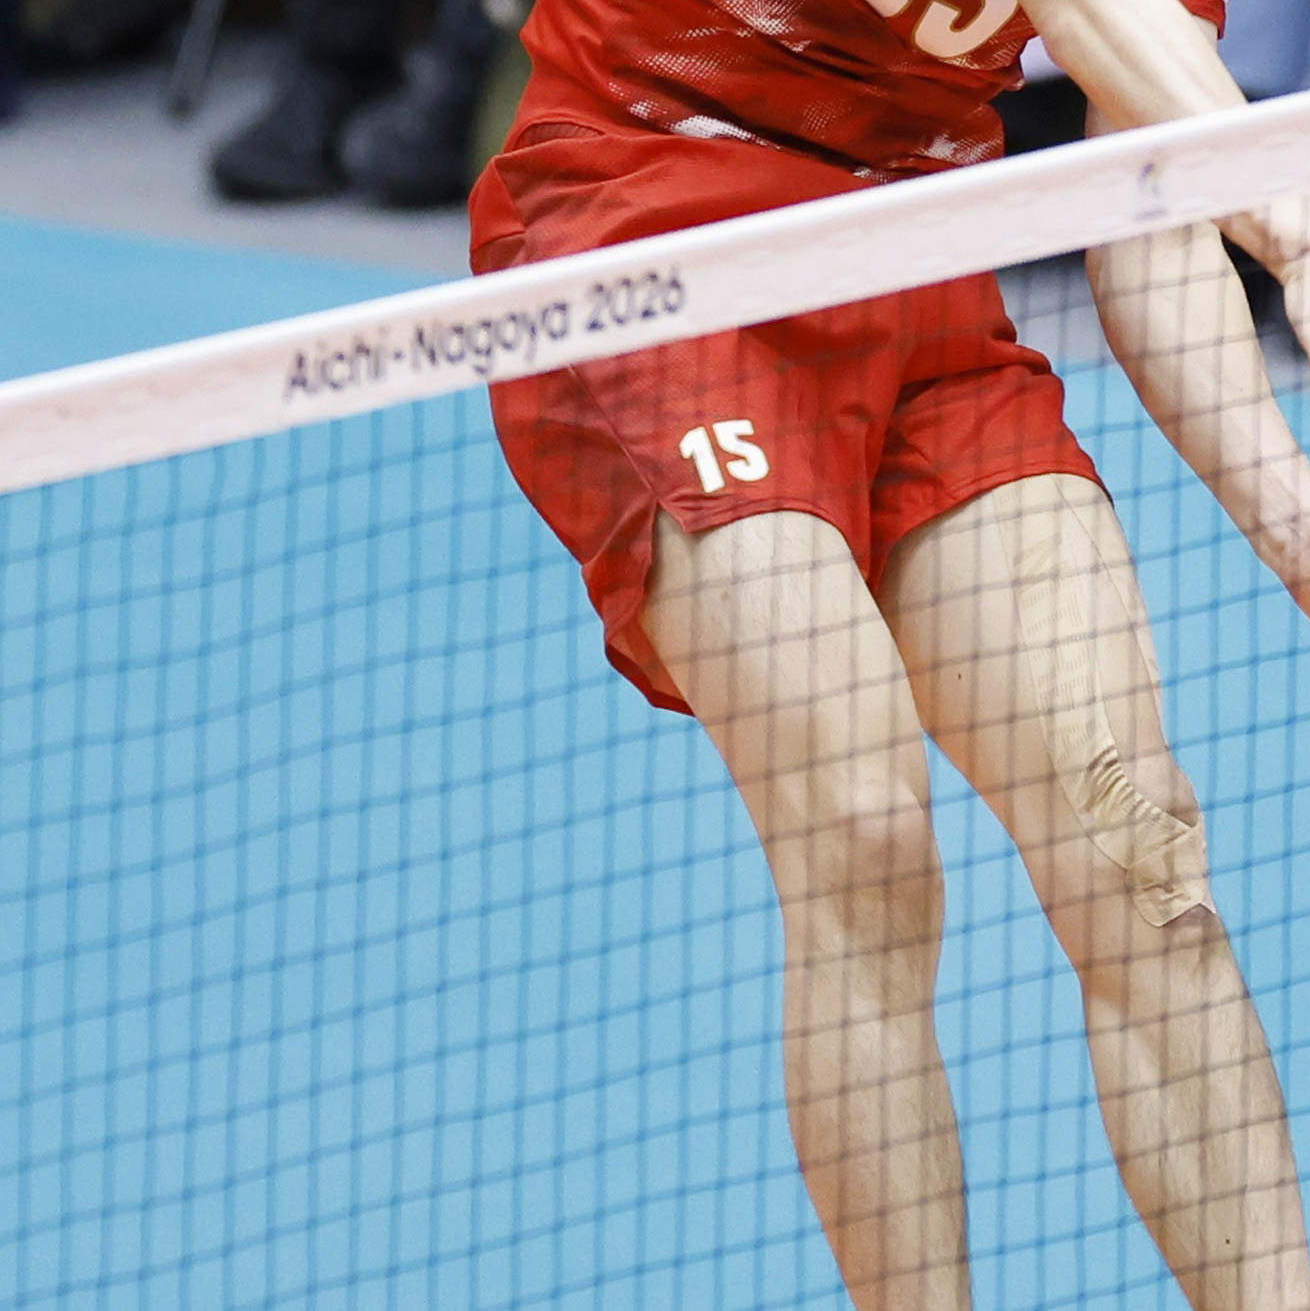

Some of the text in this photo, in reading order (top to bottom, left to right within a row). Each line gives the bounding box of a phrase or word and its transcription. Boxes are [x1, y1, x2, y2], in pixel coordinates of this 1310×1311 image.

[284, 265, 687, 401] Aichi-Nagoya 2026
[679, 418, 771, 494] 15
